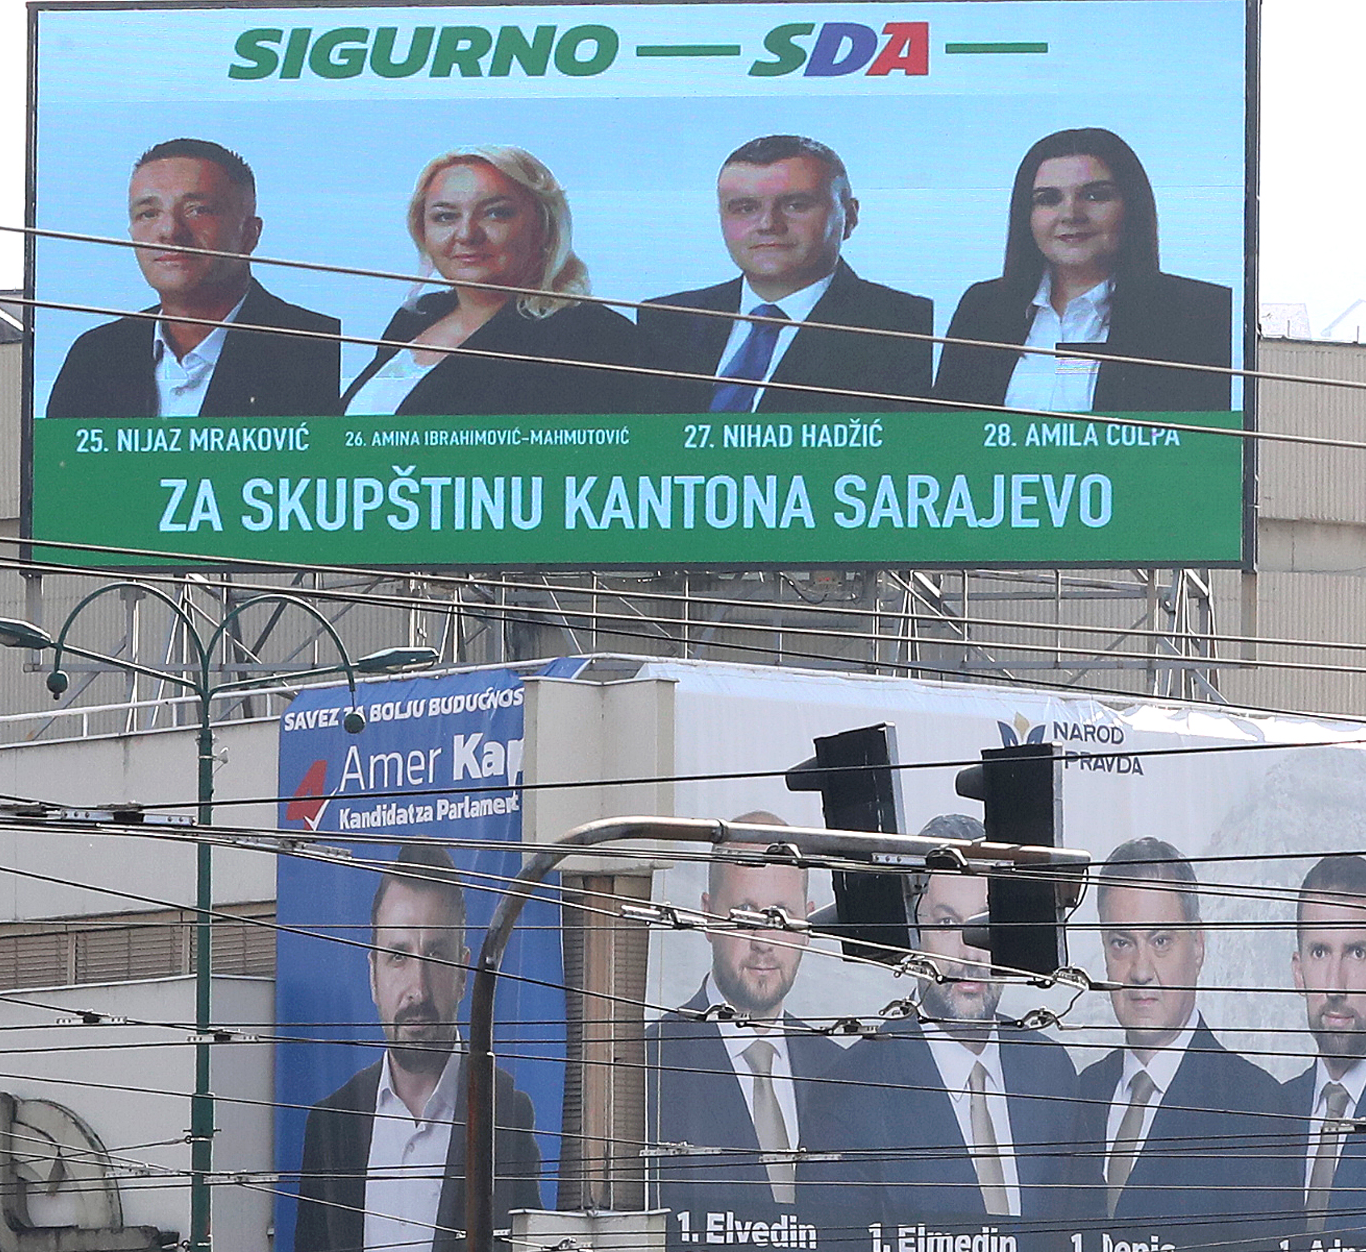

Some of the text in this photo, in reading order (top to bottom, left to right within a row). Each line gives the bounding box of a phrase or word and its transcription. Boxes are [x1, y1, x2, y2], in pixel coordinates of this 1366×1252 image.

[229, 21, 930, 79] SIGURNO SDA
[76, 422, 310, 452] 25. NIJAZ MRAKOVIĆ
[345, 430, 419, 447] 26. AMINA
[684, 418, 883, 447] 27. NIHAD HADŽIĆ
[984, 424, 1098, 447] 28. AMILA
[159, 466, 1113, 532] ZA SKUPŠTINU KANTONA SARAJEVO
[284, 707, 340, 731] SAVEZ
[370, 699, 426, 723] BOLJU
[1053, 722, 1124, 745] NAROD
[339, 745, 442, 792] Amer
[1065, 751, 1144, 776] PRAVDA
[285, 760, 328, 830] 4
[339, 803, 433, 830] Kandidat za
[677, 1211, 817, 1249] 1. Elvedin
